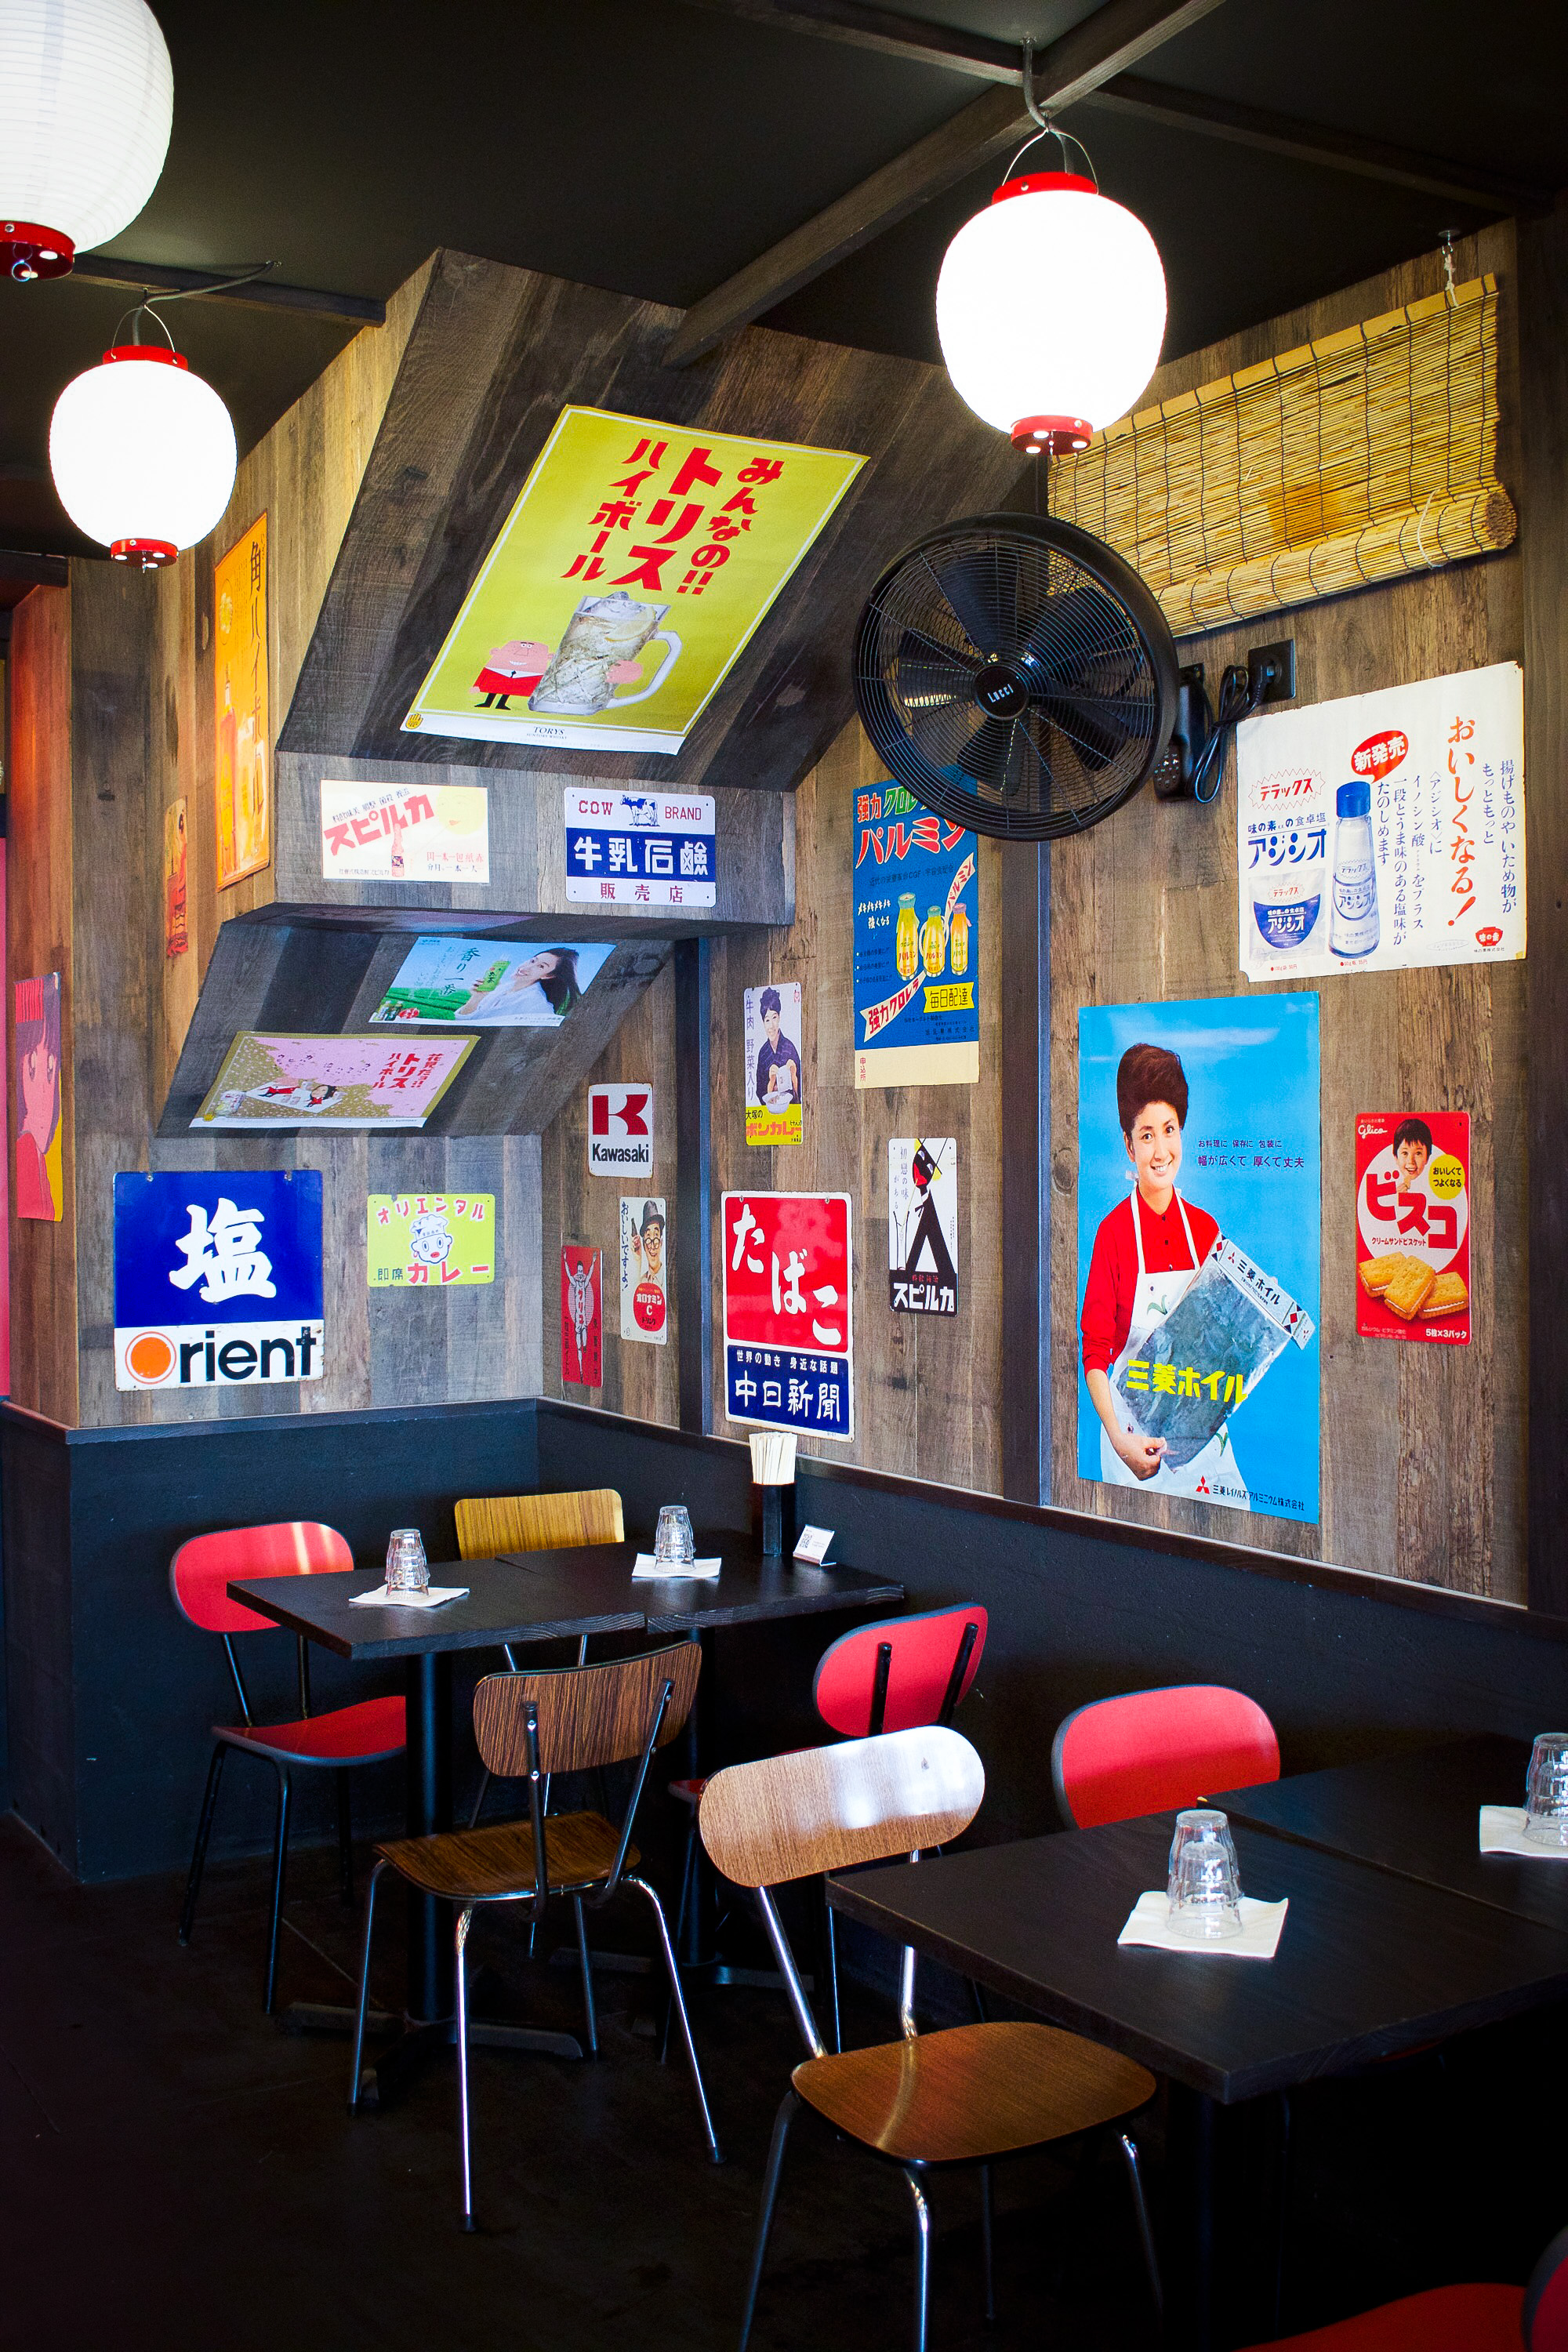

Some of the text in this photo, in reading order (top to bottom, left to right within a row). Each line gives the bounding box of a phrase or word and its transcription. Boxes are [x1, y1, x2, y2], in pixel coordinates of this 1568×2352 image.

[561, 438, 669, 582] ハイボール
[608, 447, 724, 591] トリス
[249, 541, 265, 819] 角ハイボール
[1354, 736, 1406, 772] 新発売
[1260, 777, 1314, 801] デラックス
[1482, 763, 1496, 844] もっともっと
[578, 800, 702, 822] COW BRAND
[1377, 781, 1392, 867] たのしめます
[855, 816, 966, 869] パルミン
[1247, 828, 1327, 869] アジシオ
[599, 881, 684, 904] 販売店
[1272, 886, 1300, 898] デラックス
[1267, 914, 1305, 934] アジシオ
[441, 947, 481, 996] 香り一番
[868, 978, 920, 1035] 強力クロレラ
[746, 998, 755, 1102] 牛肉 野菜入り
[387, 1052, 421, 1089] トリス
[746, 1120, 802, 1137] ボンカレー
[1198, 1139, 1283, 1149] お料理に 保存に 包装に
[1358, 1123, 1388, 1139] Glico
[592, 1142, 650, 1163] Kawasaki
[1197, 1155, 1305, 1169] 幅が広くて 厚くて丈夫
[1432, 1167, 1462, 1177] おいしくて
[1432, 1178, 1462, 1189] つよくなる
[377, 1196, 485, 1226] オリエンタル
[1366, 1170, 1458, 1250] ビスコ
[169, 1197, 277, 1303] 塩
[1371, 1236, 1427, 1247] クリームサンドビスケット
[376, 1262, 489, 1285] 即席 カレー
[731, 1203, 842, 1346] たばこ
[1237, 1259, 1281, 1305] 三菱ホイル
[645, 1305, 653, 1316] C
[736, 1349, 839, 1375] 世界の動き 身近な話題
[735, 1370, 841, 1423] 中日新聞
[1125, 1357, 1250, 1406] 三菱ホイル
